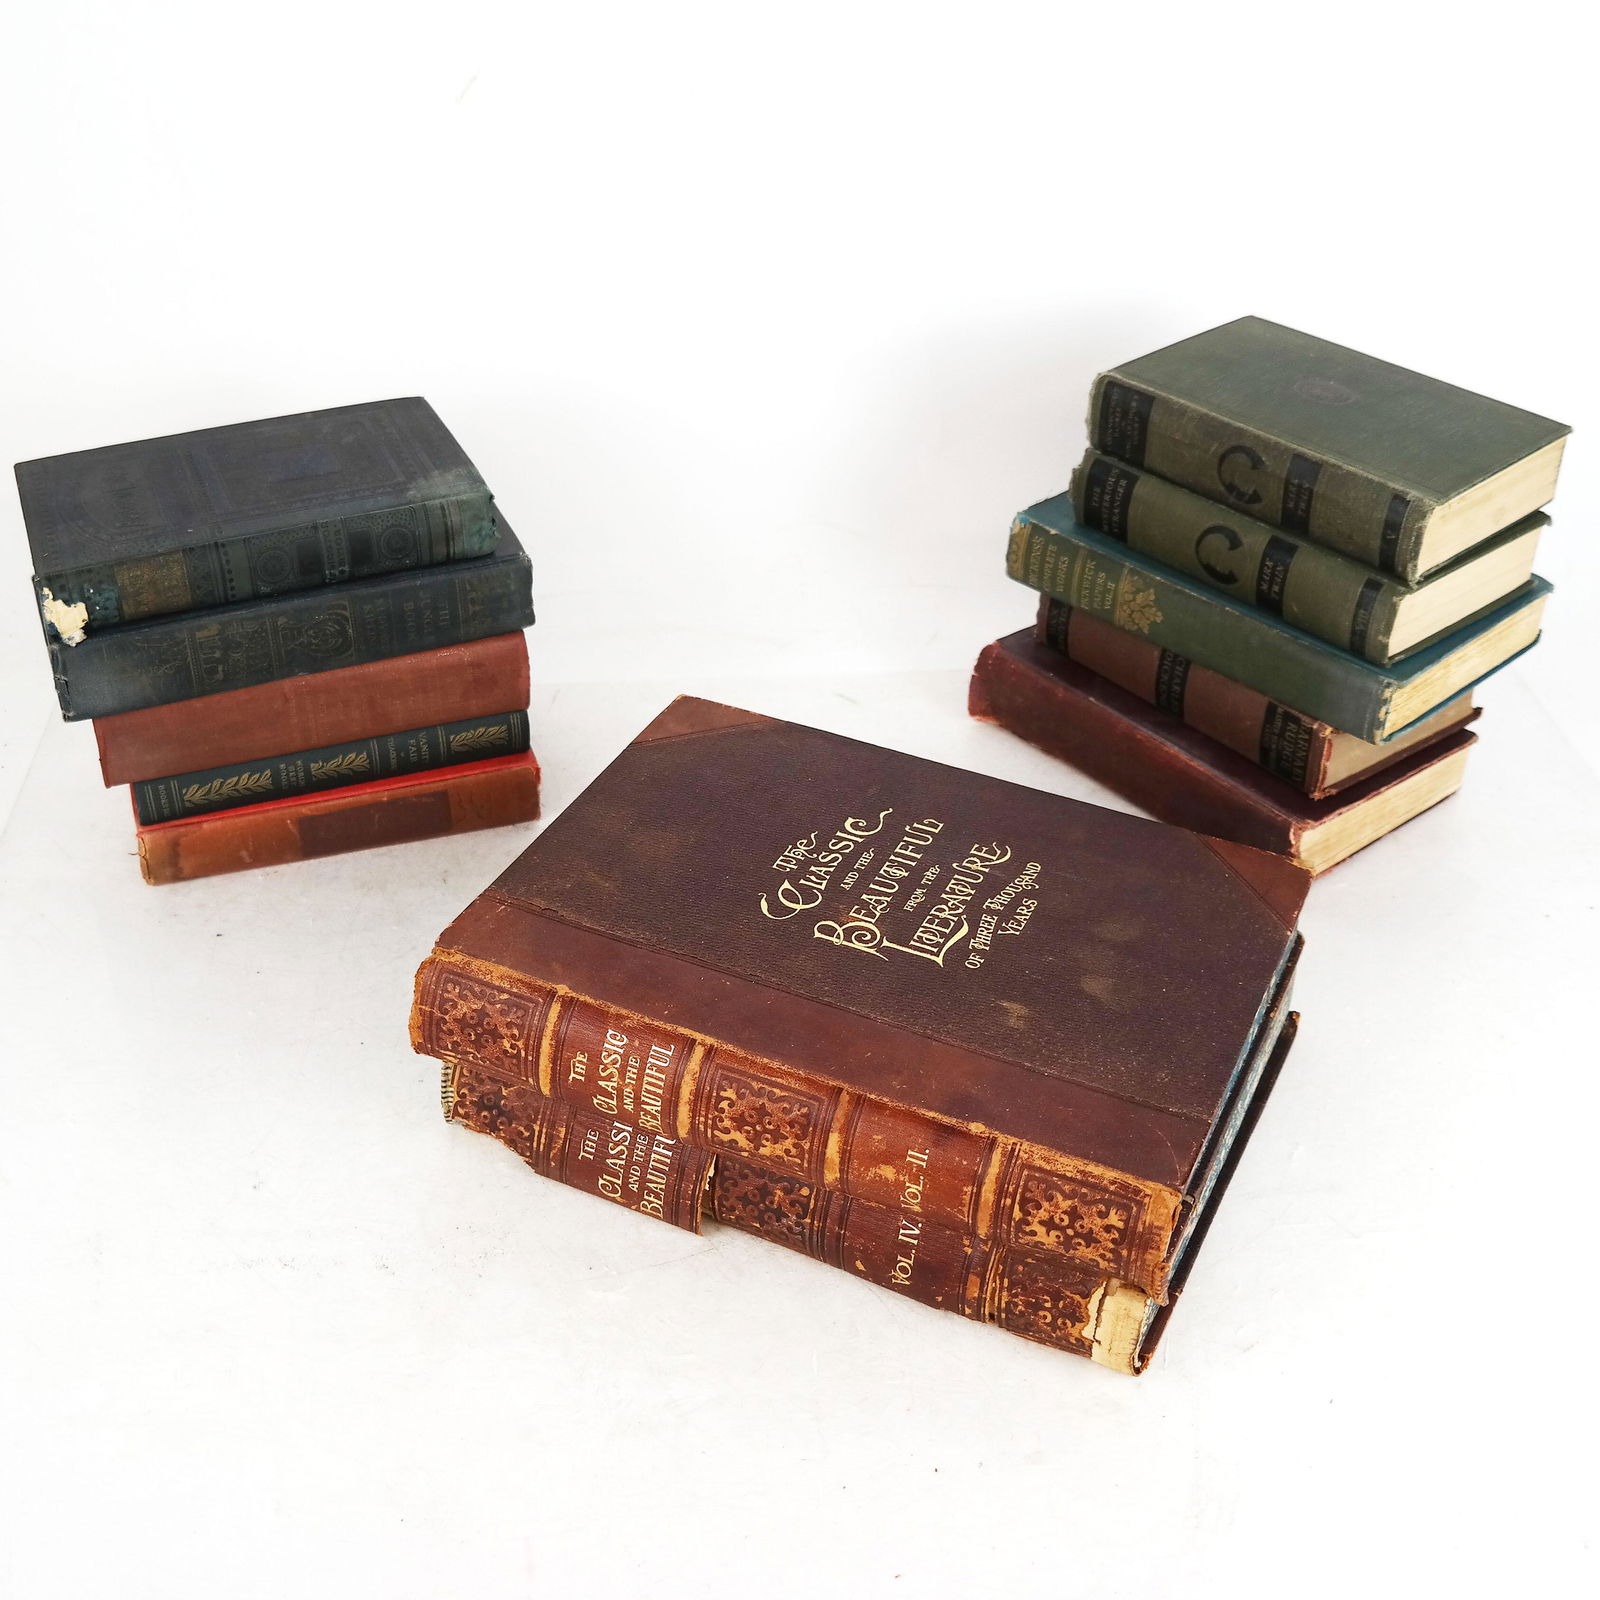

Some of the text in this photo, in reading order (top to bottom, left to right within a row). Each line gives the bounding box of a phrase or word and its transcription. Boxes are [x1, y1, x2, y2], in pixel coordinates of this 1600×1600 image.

[758, 807, 893, 920] CLASSIC
[813, 818, 945, 962] BEAUTIFUL
[840, 848, 875, 891] AND THE
[903, 864, 941, 913] FROM THE
[880, 841, 1012, 968] LITERATURE
[964, 861, 1042, 969] OF THREE THOUSAND
[997, 898, 1038, 936] YEARS
[568, 1051, 589, 1083] THE
[592, 1029, 629, 1115] CLASSIC
[622, 1055, 641, 1113] AND THE
[638, 1044, 676, 1135] BEAUTIFUL
[578, 1128, 599, 1161] THE
[598, 1121, 634, 1198] CLASSI
[628, 1133, 650, 1193] AND THE
[640, 1134, 677, 1219] BEAUTIF
[900, 1148, 930, 1213] VOL. II.
[891, 1219, 923, 1285] VOL. IV.
